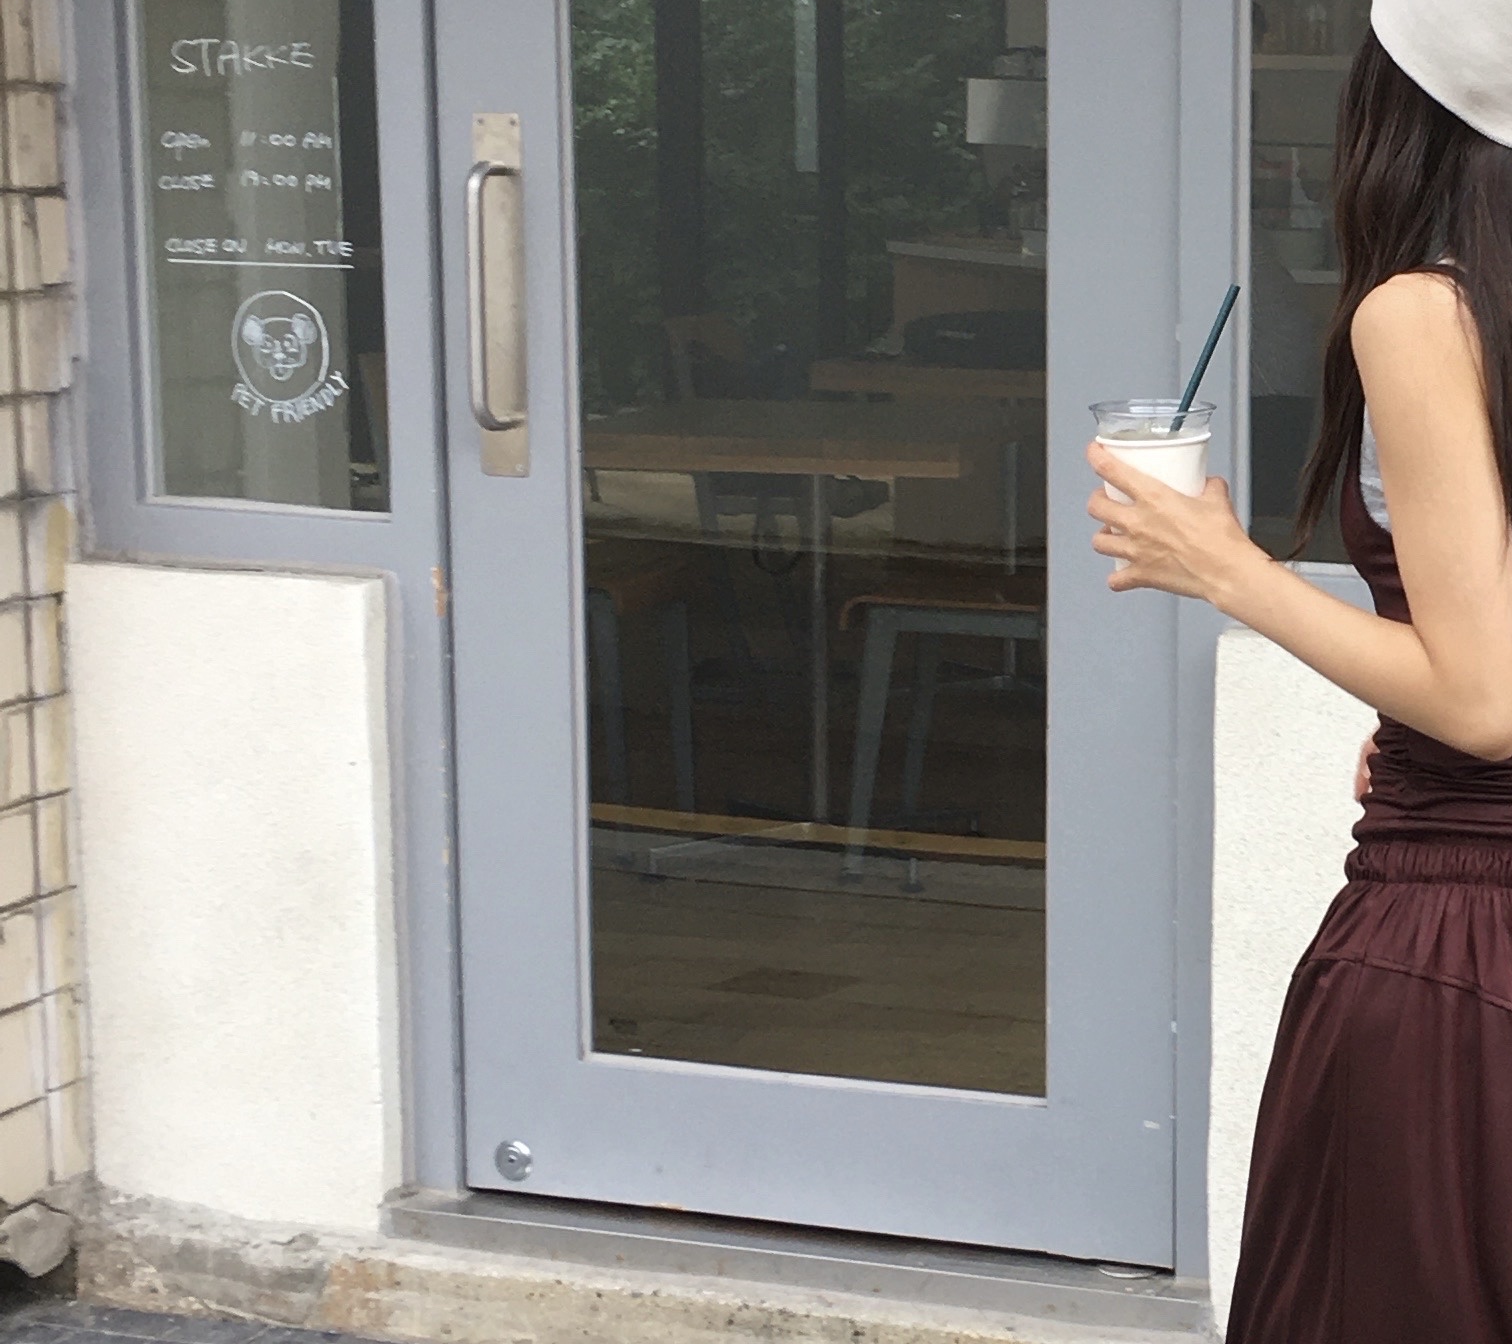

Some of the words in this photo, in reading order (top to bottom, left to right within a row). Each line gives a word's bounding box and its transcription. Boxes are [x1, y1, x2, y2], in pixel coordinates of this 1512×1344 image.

[171, 38, 315, 76] STAKKE
[157, 173, 215, 190] CLOSE
[304, 173, 332, 193] PM
[164, 238, 219, 255] CLOSE
[230, 382, 266, 417] PET
[270, 370, 350, 424] FRIENDLY
